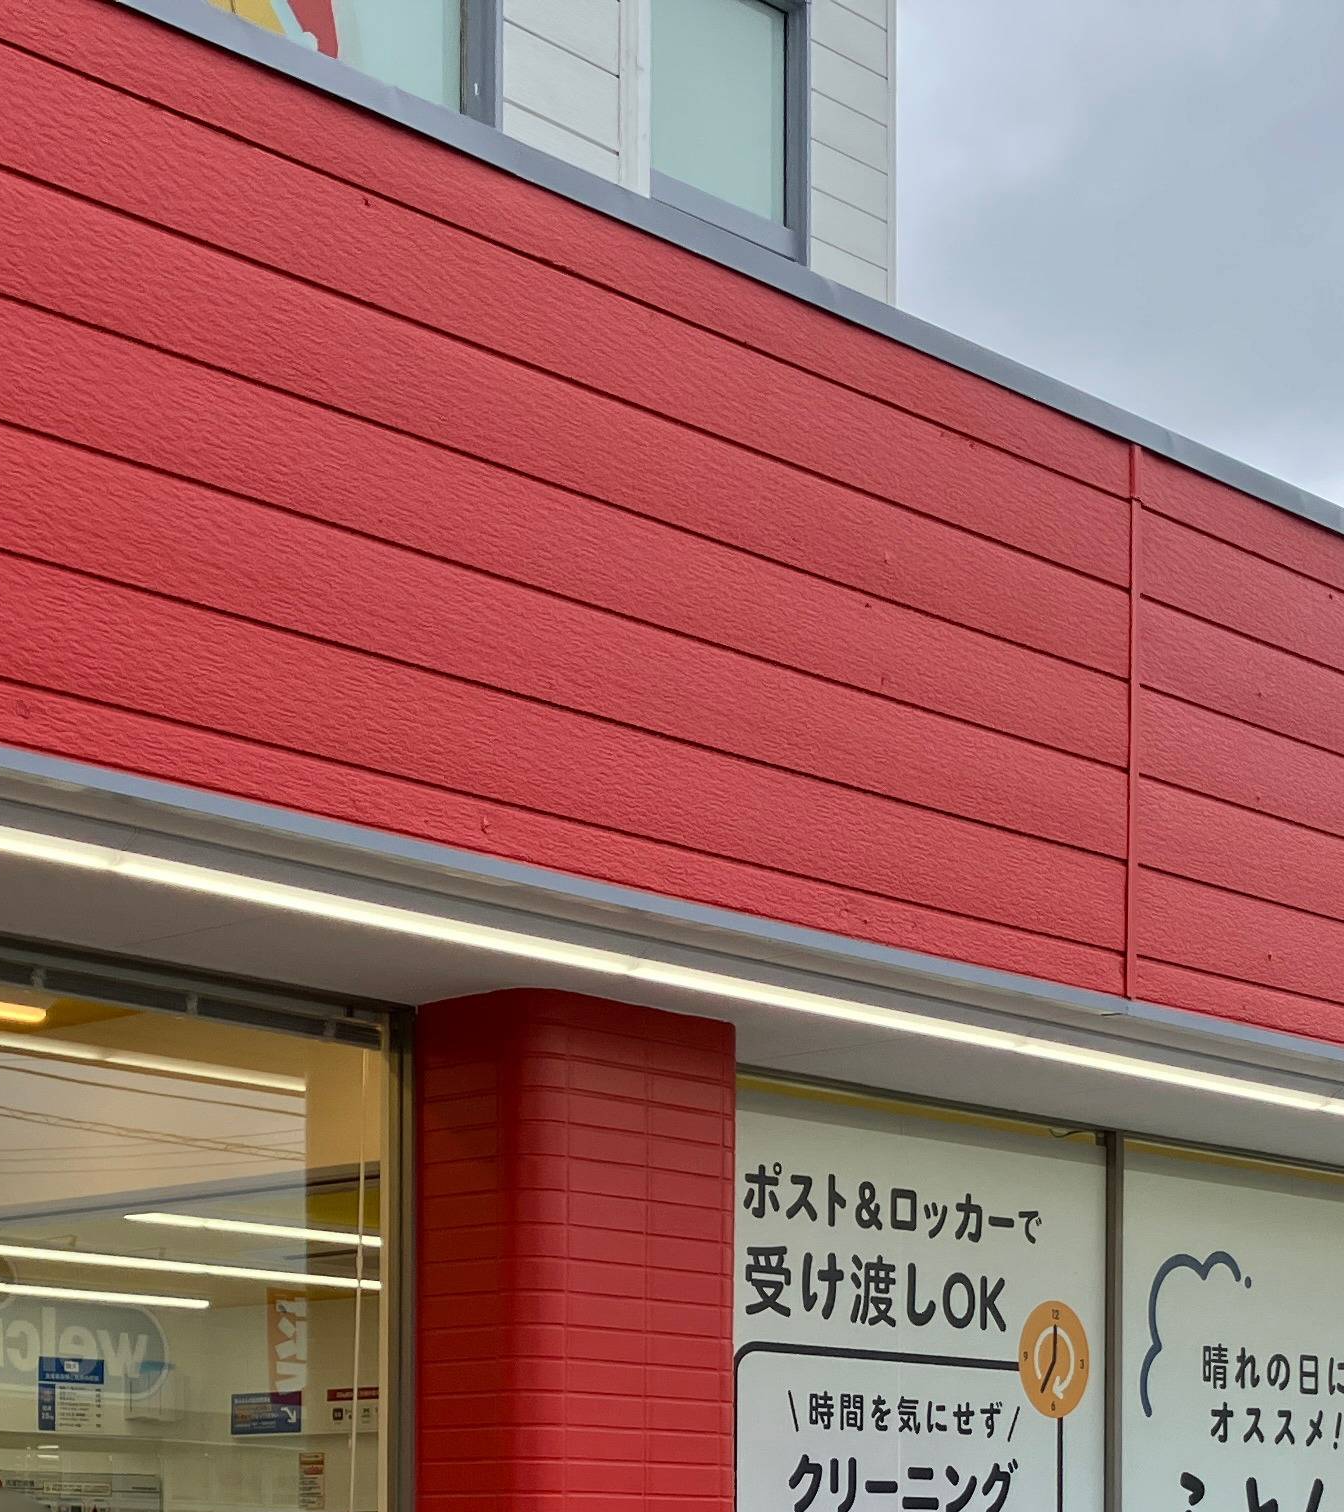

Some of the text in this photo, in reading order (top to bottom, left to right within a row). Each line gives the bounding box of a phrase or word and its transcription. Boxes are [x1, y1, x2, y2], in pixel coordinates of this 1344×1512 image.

[743, 1162, 1043, 1244] ポスト&ロッカーで
[744, 1245, 1007, 1333] 受け渡しOK
[1051, 1309, 1060, 1321] 12
[808, 1393, 1005, 1437] 時間を気にせず
[1210, 1403, 1343, 1450] オススメ!
